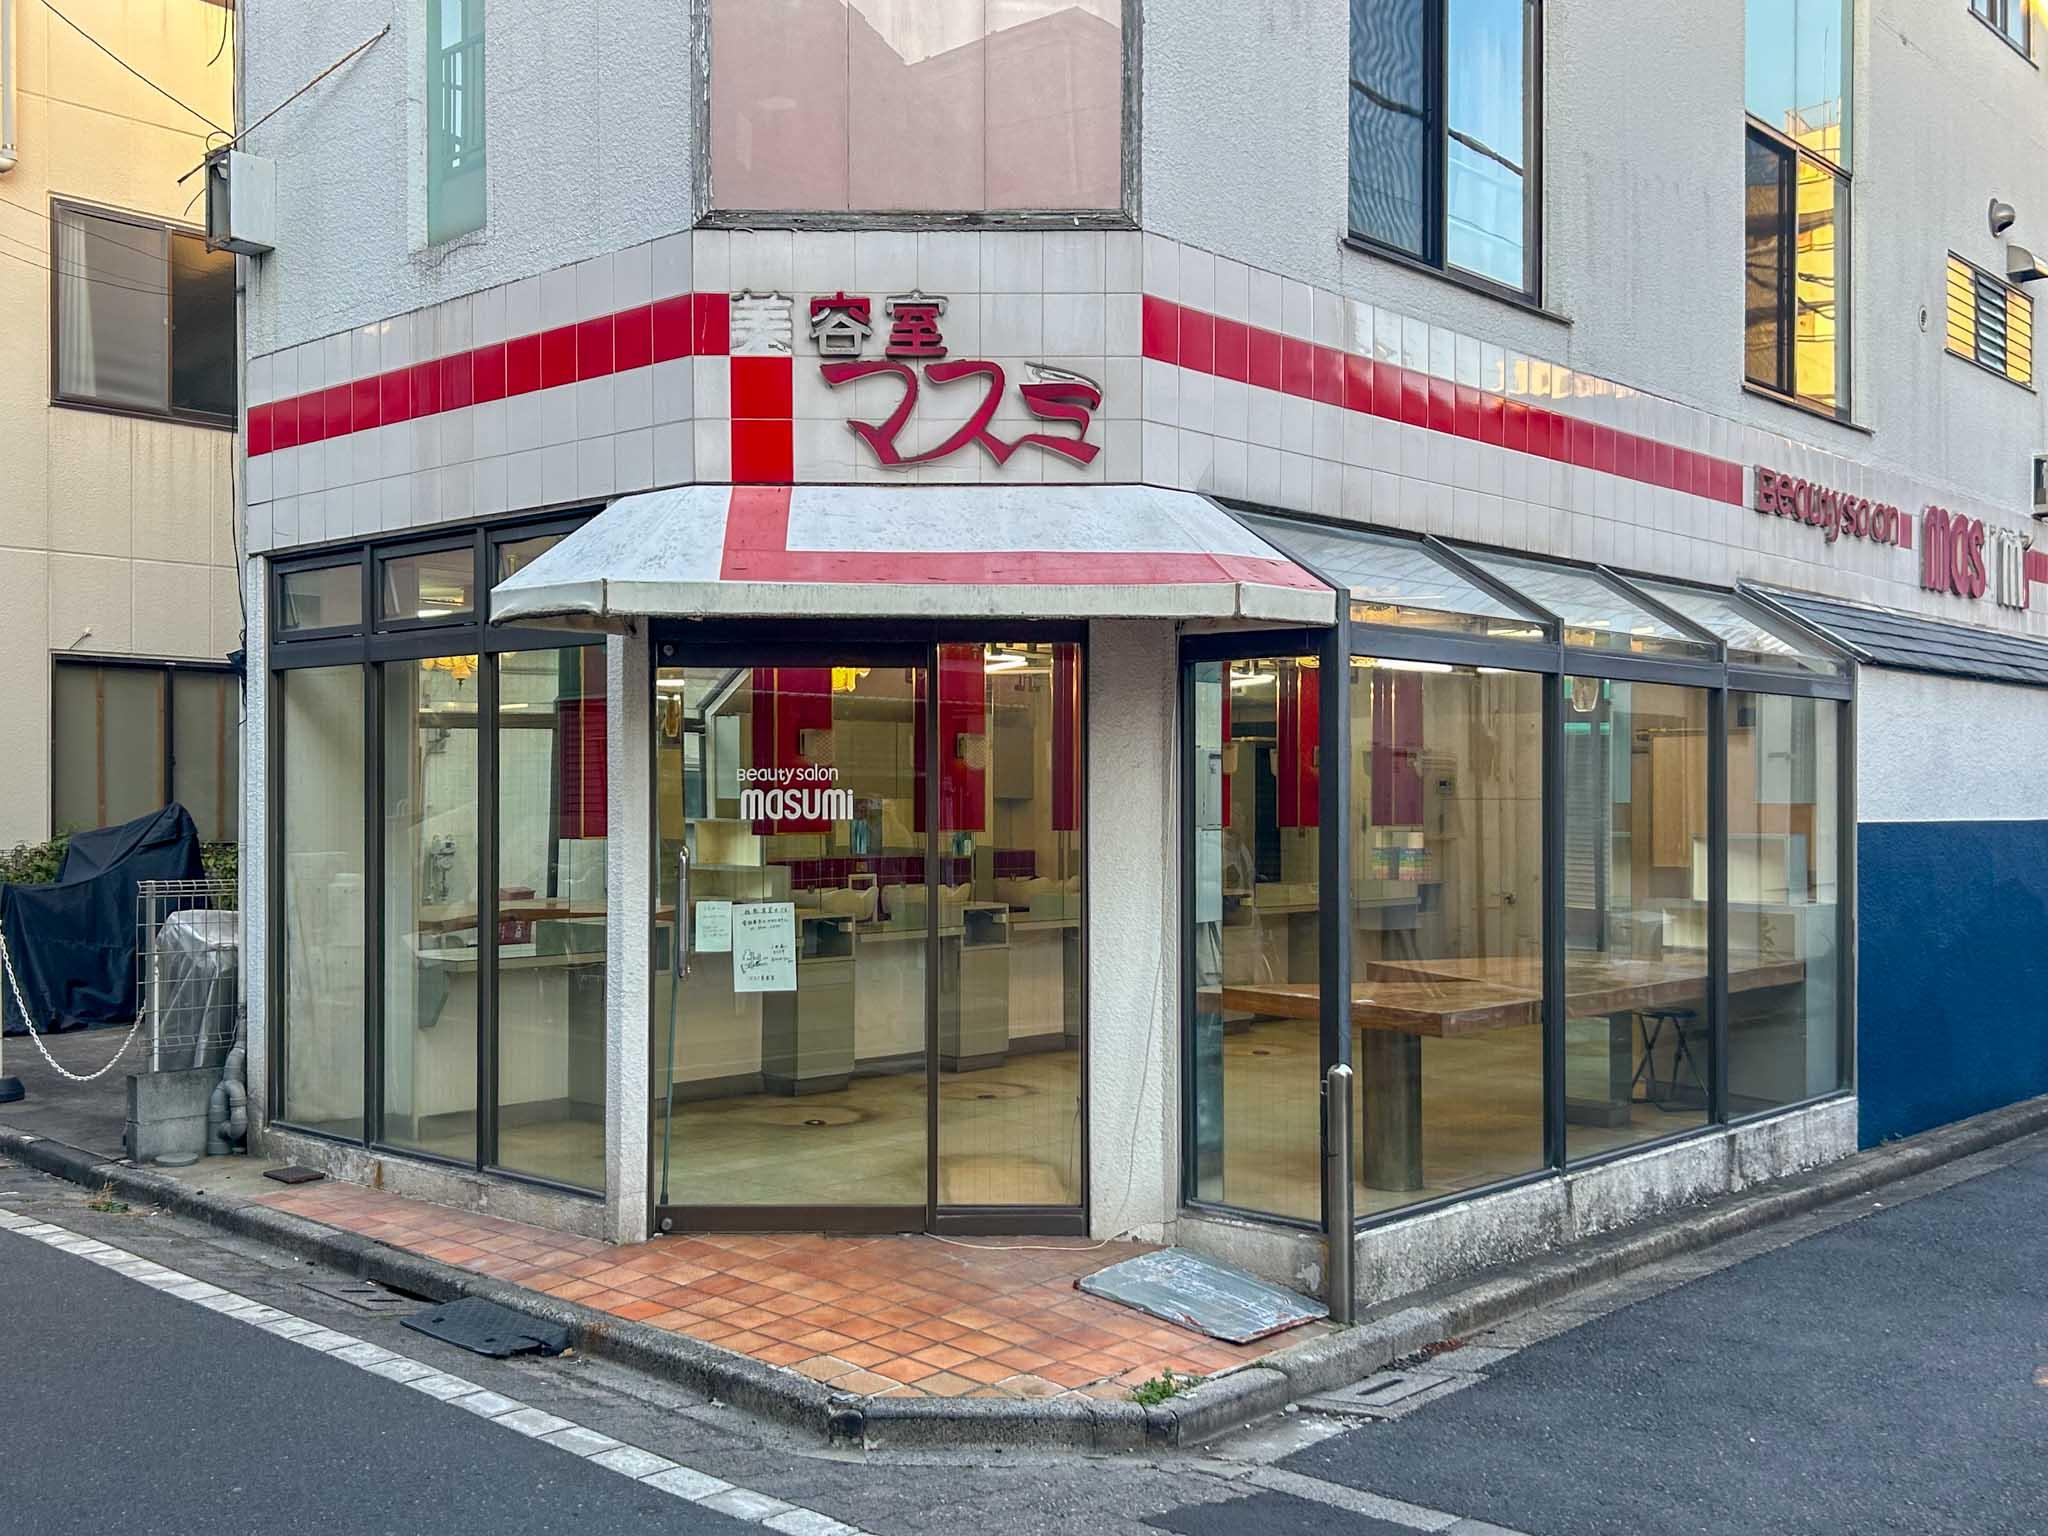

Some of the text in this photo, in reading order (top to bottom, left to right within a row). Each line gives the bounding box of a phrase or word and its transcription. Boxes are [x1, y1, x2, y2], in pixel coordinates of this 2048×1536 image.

[731, 287, 948, 357] 美容室
[819, 358, 1104, 466] マスミ
[736, 763, 839, 785] Beauty salon
[740, 788, 854, 820] masumi
